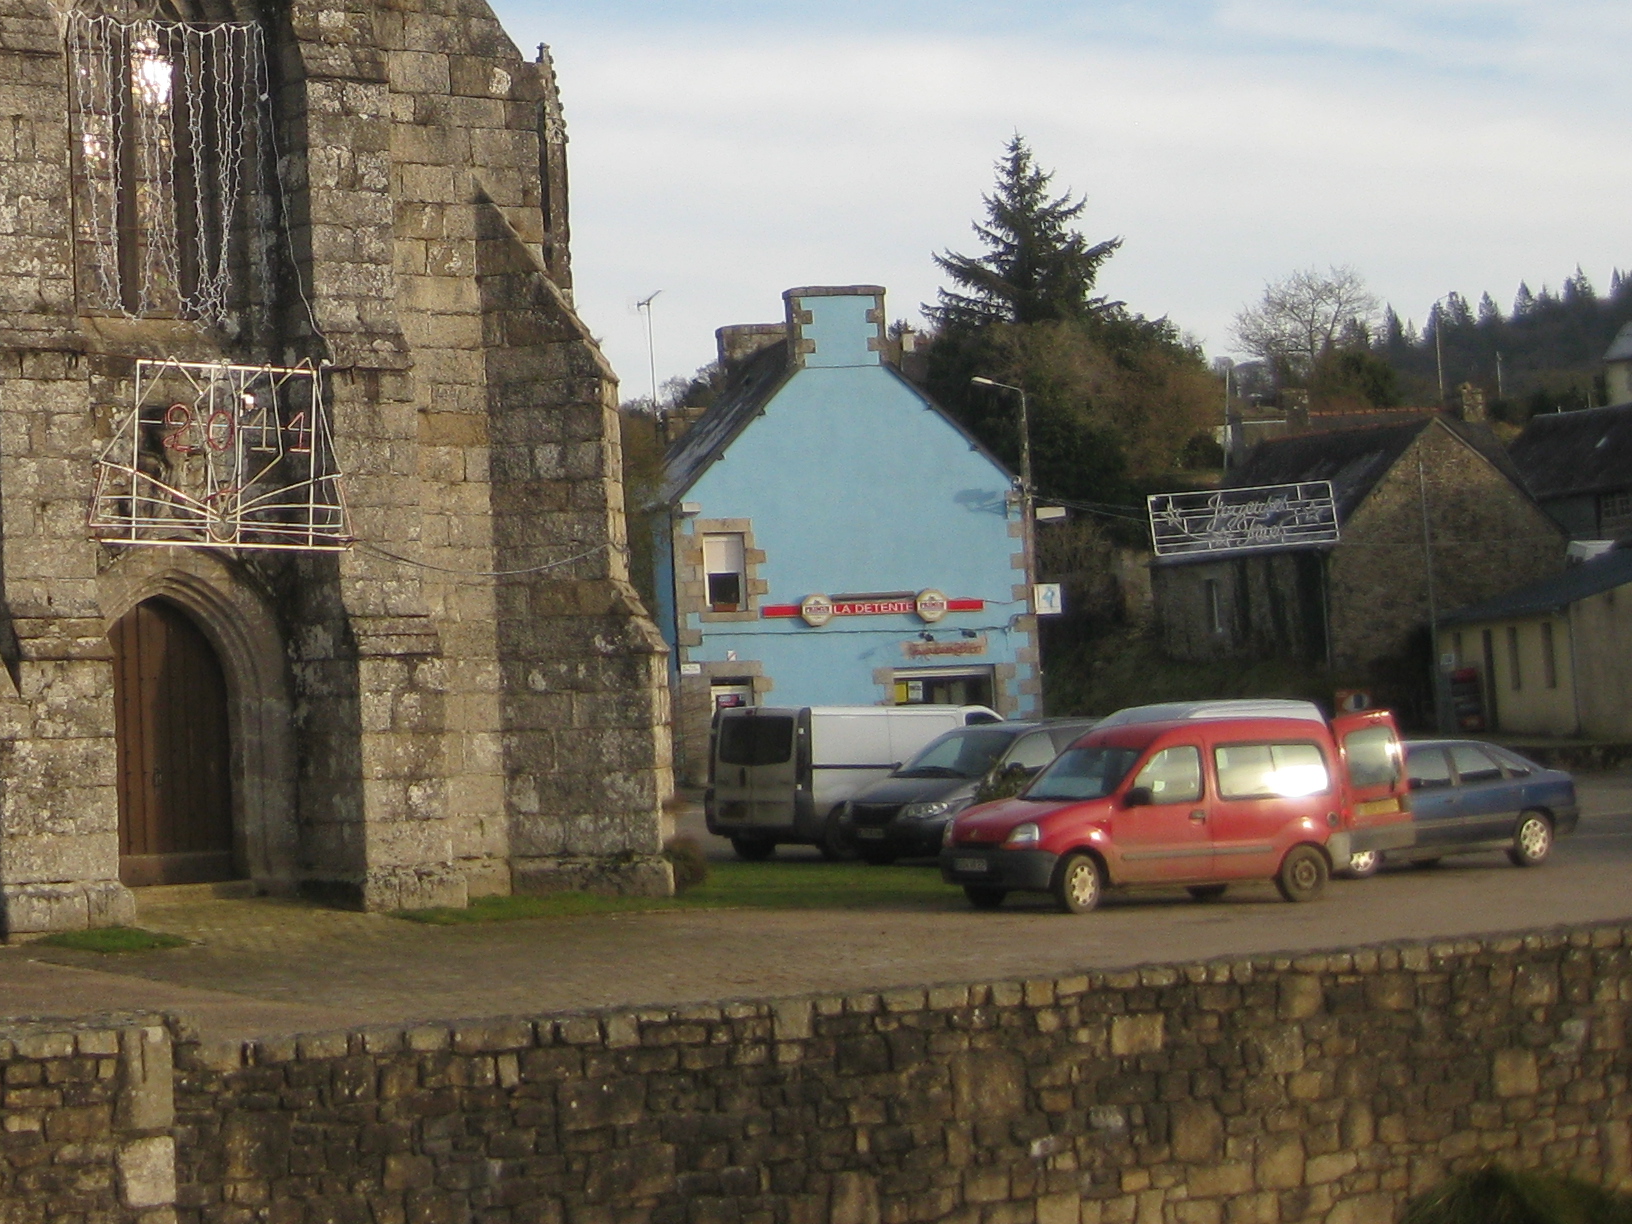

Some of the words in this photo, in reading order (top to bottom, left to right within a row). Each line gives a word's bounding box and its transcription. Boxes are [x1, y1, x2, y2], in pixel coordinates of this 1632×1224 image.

[163, 402, 312, 454] 2011
[1206, 491, 1290, 532] Joyeuses
[833, 603, 852, 614] LA
[854, 601, 915, 614] DETENTE
